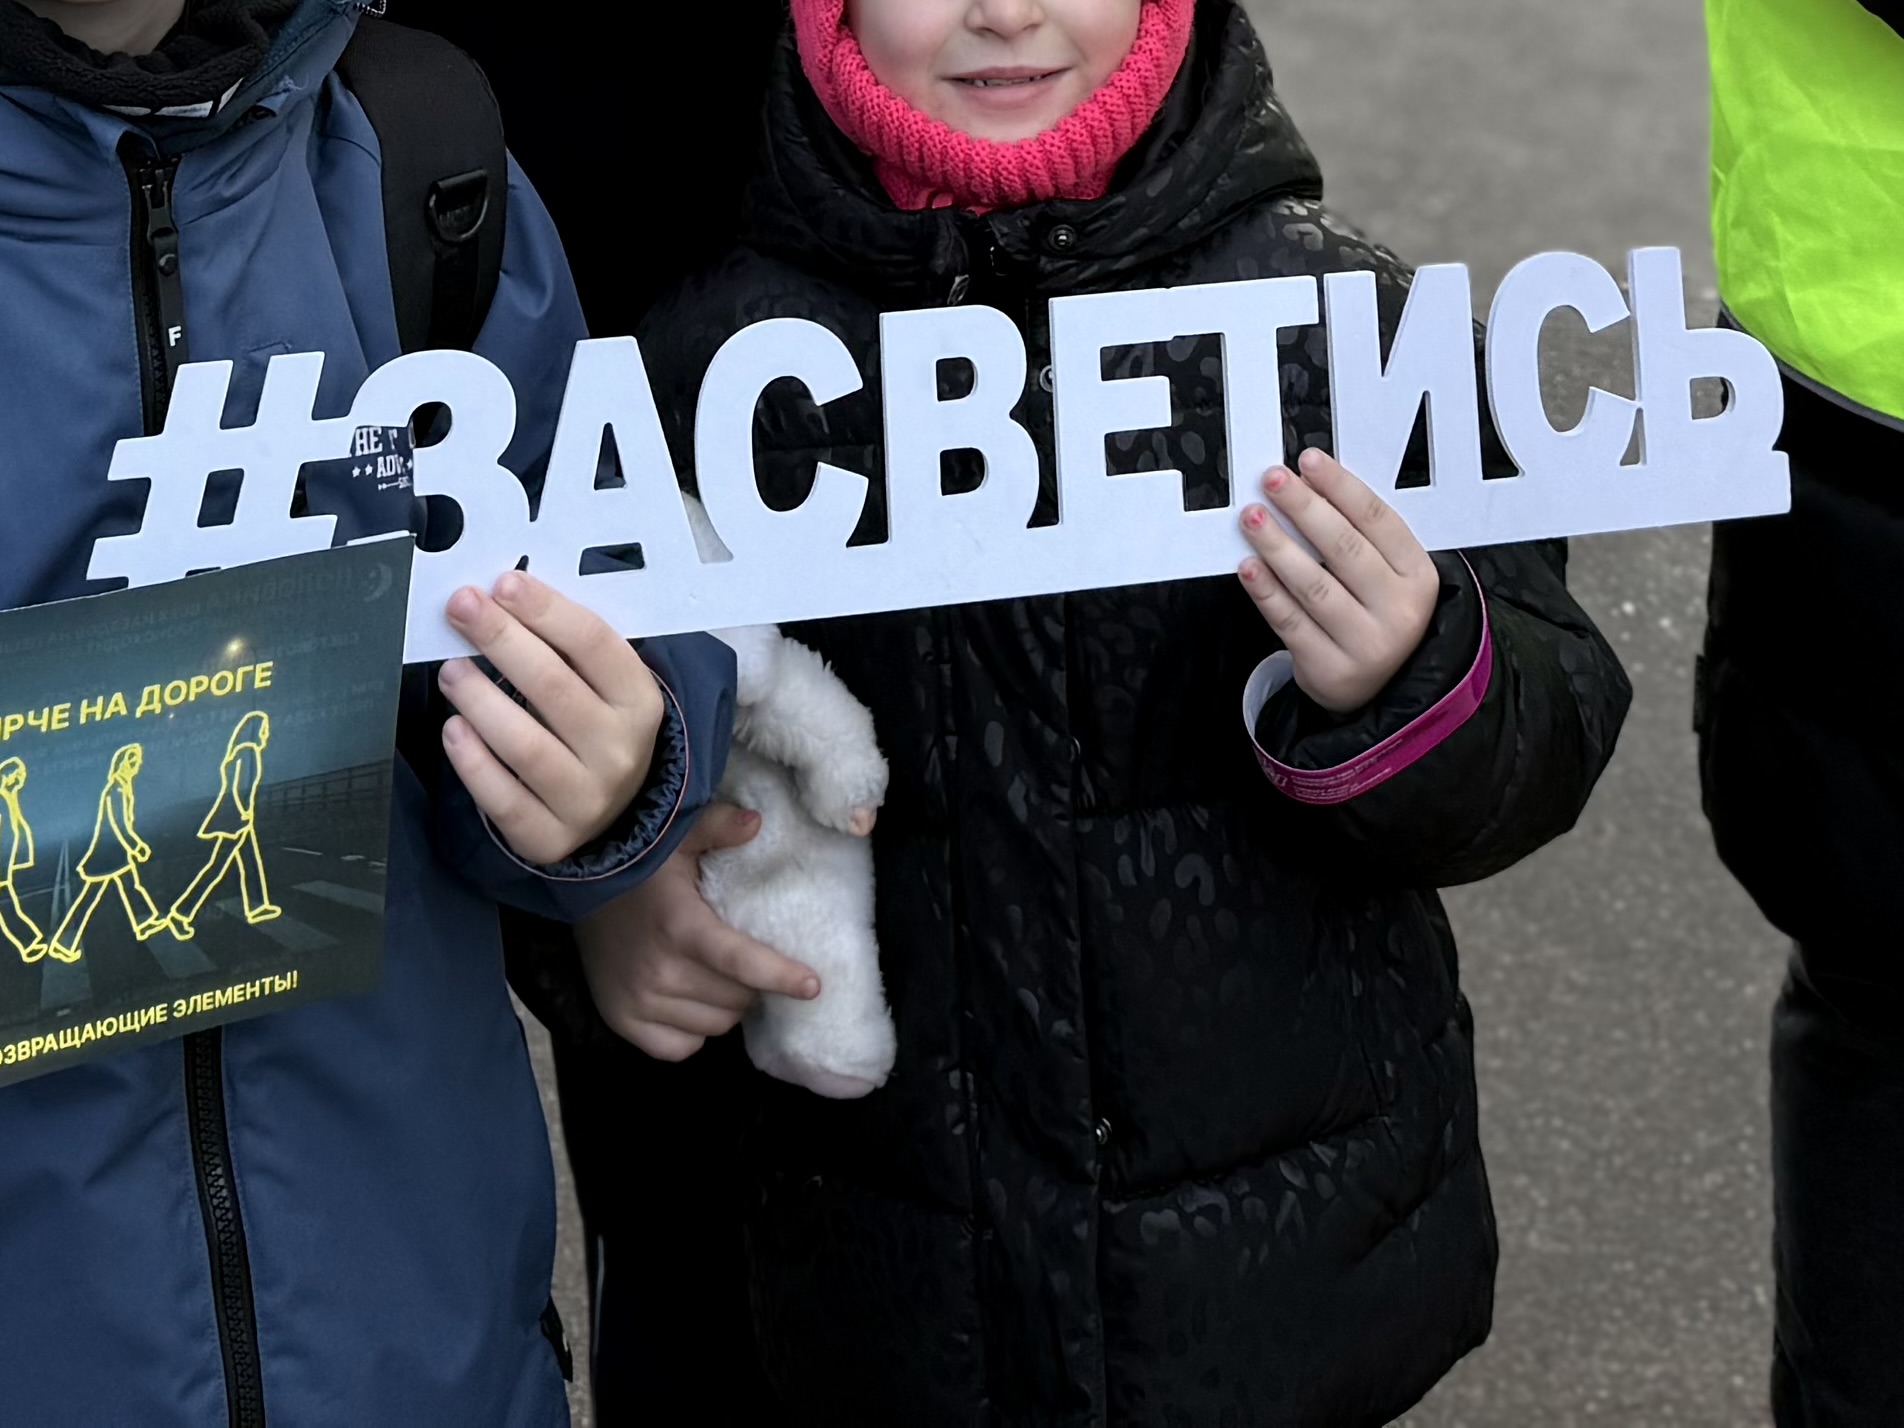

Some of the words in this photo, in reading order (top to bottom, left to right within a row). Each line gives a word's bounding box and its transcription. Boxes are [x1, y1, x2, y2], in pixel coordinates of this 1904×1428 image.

[86, 246, 1791, 594] #ЗАСВЕТИСЬ
[350, 426, 383, 457] HE
[79, 692, 128, 725] НА
[135, 661, 274, 714] ДОРОГЕ
[172, 970, 299, 1019] ЭЛЕМЕНТЫ!
